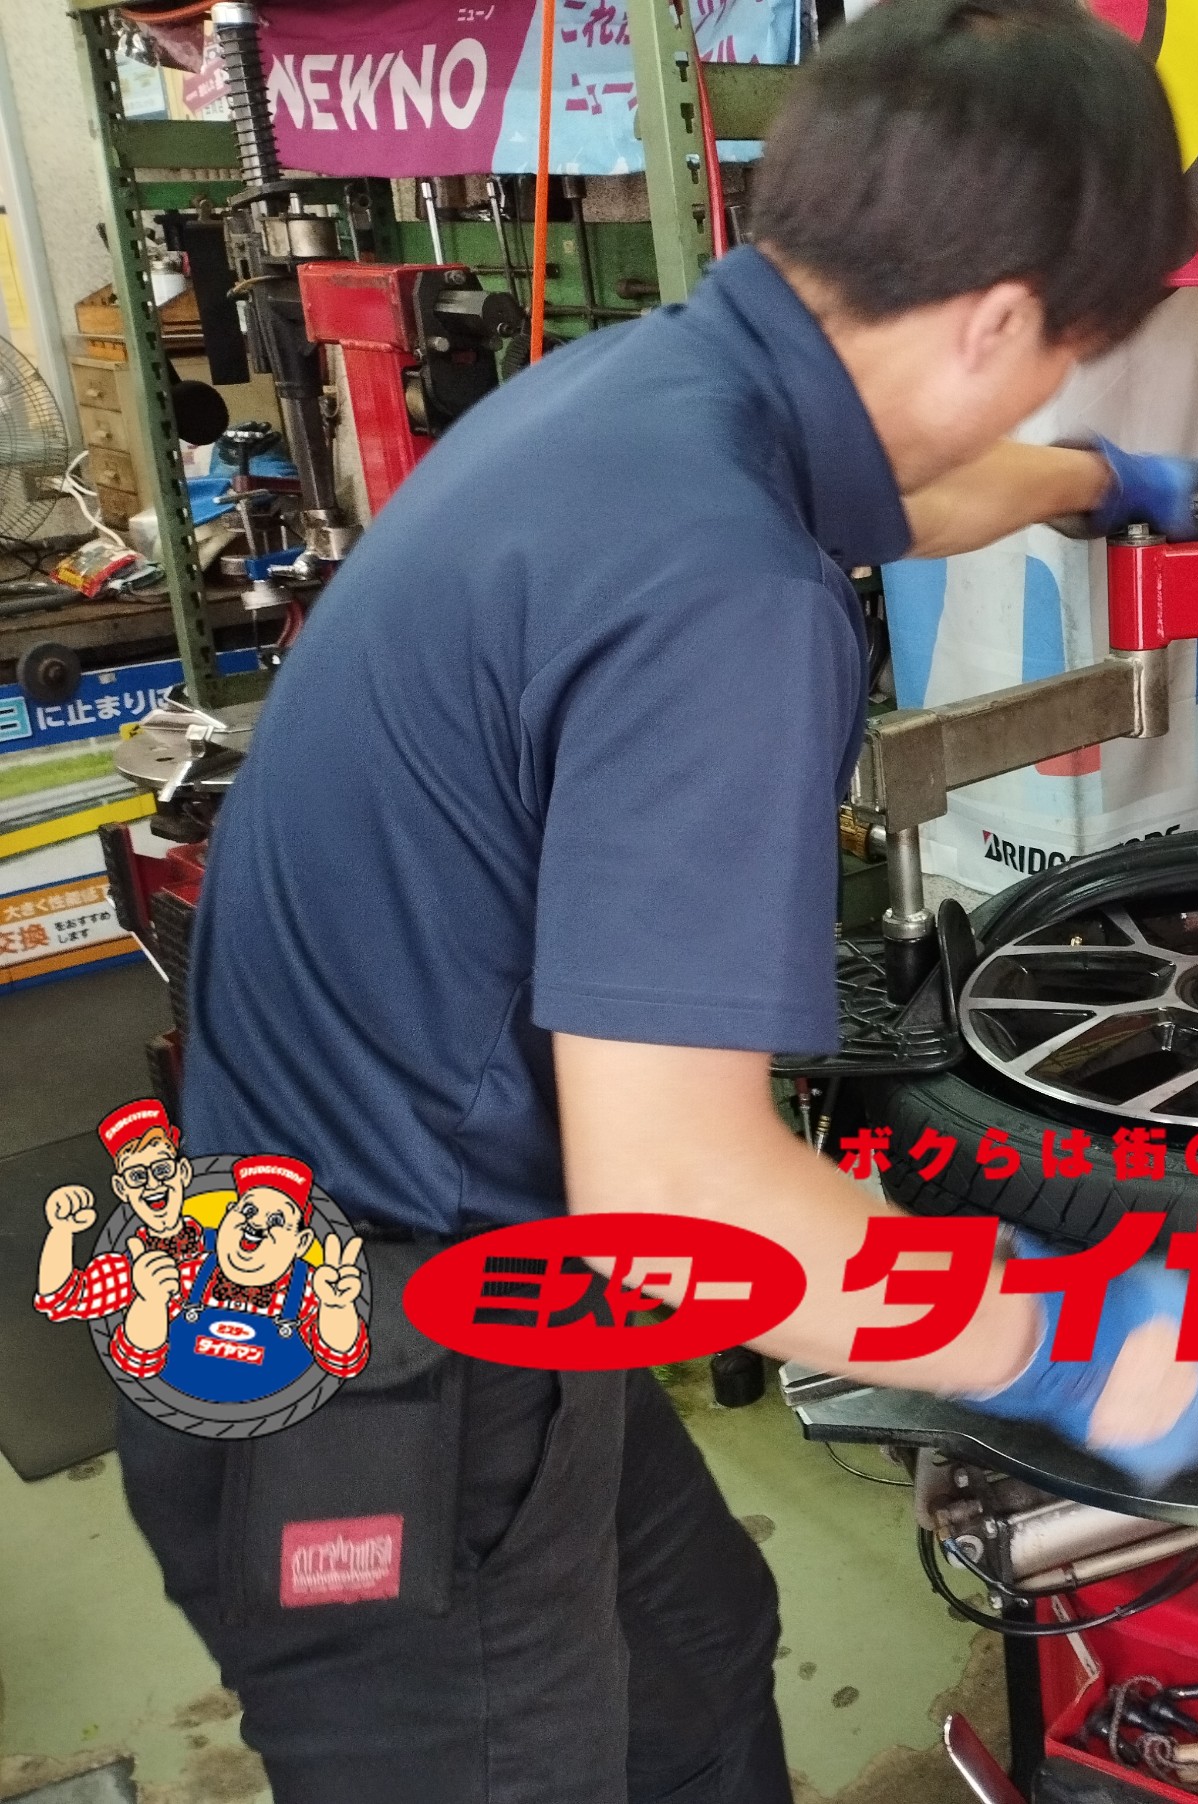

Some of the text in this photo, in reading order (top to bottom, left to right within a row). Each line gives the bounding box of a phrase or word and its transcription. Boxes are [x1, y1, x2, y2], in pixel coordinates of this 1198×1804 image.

[561, 0, 631, 48] これ
[265, 37, 488, 131] NEWNO
[565, 72, 638, 116] ニュー
